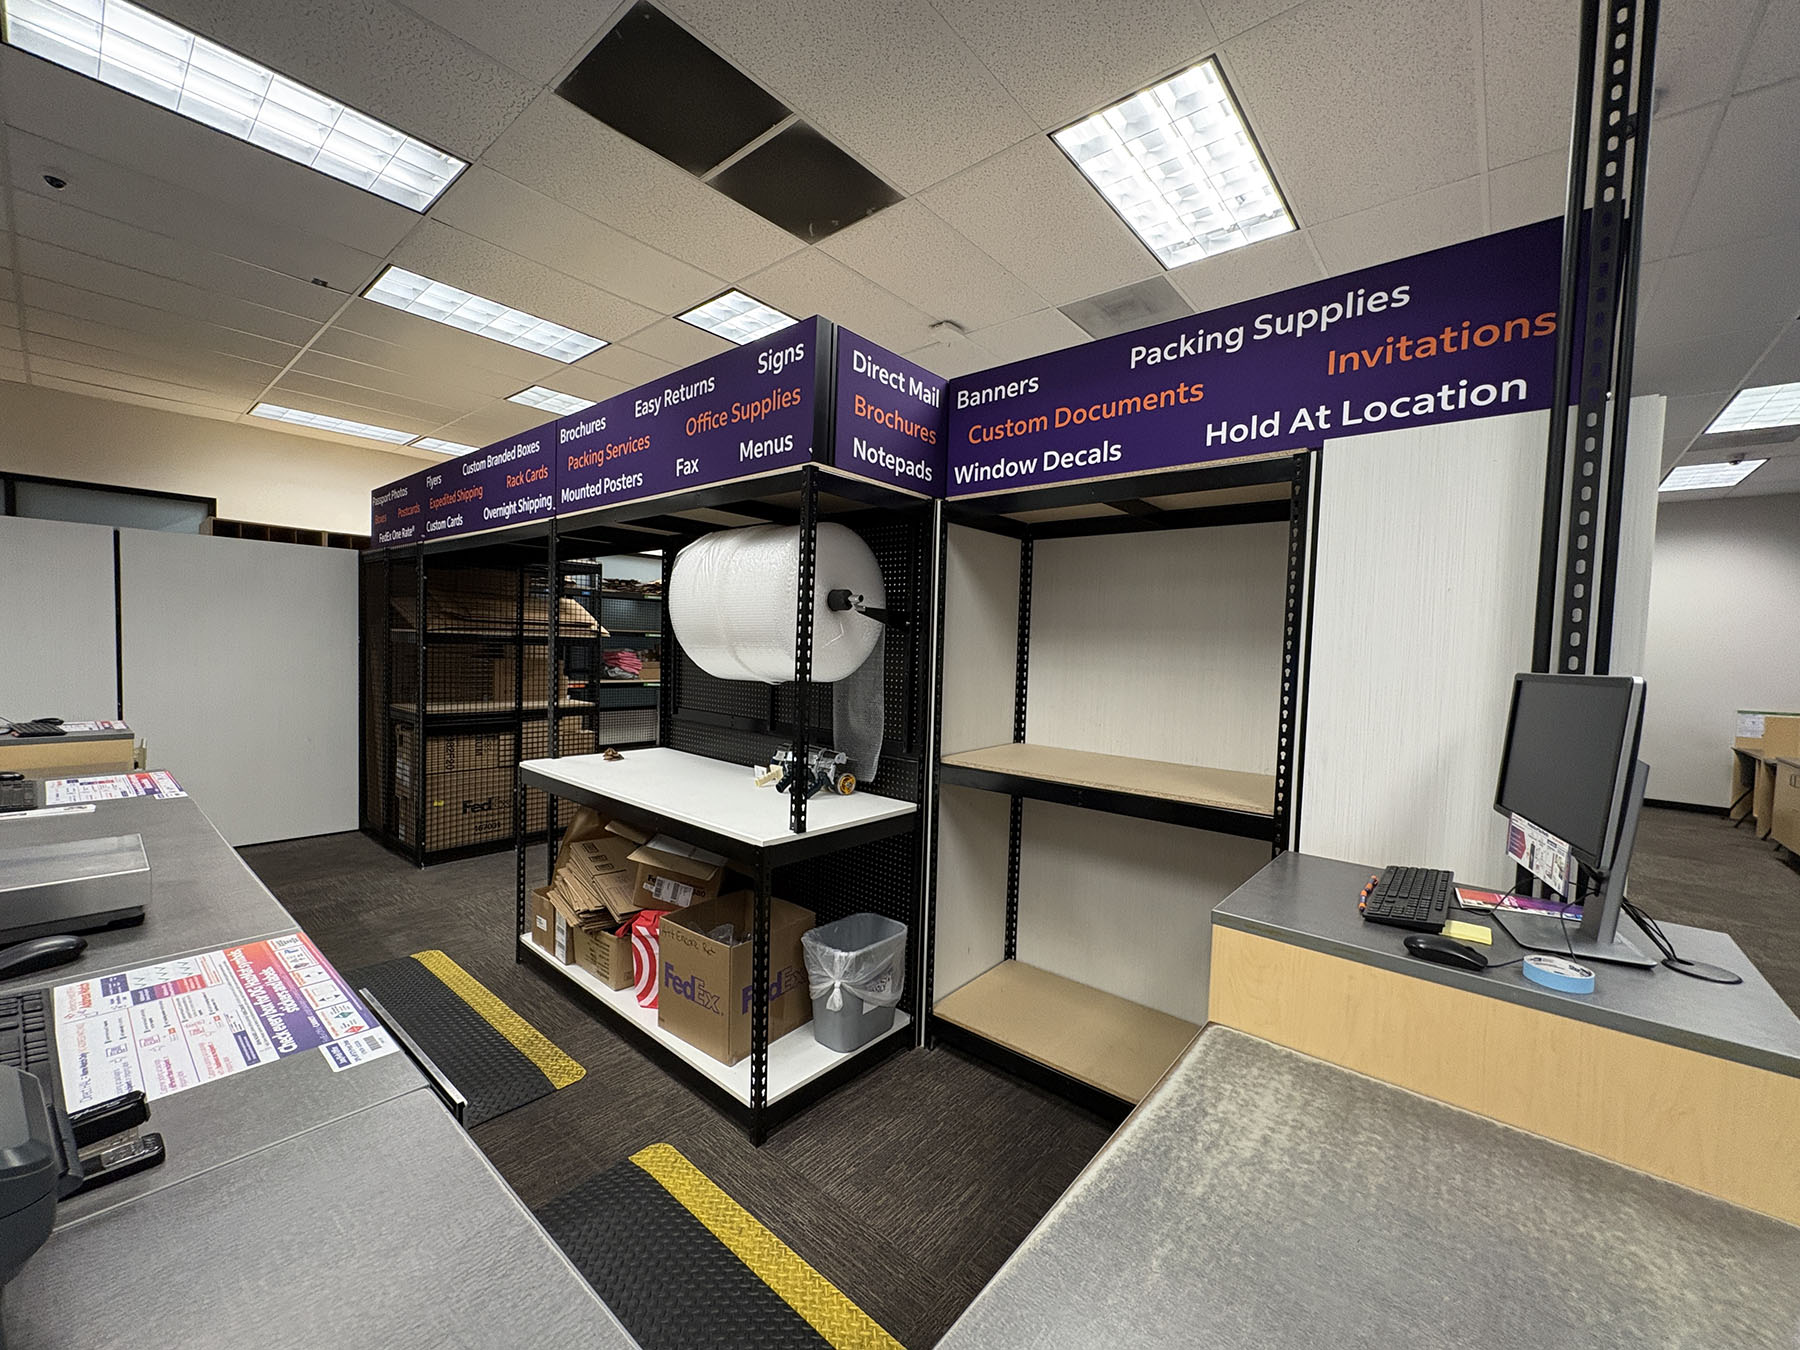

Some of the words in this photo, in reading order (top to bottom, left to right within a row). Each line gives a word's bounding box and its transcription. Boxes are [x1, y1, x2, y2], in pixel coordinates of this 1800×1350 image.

[1130, 324, 1243, 369] Packing
[1252, 284, 1411, 340] Supplies
[1327, 310, 1555, 375] Invitations
[758, 344, 804, 374] Signs
[853, 350, 905, 392] Direct
[909, 377, 939, 408] Mail
[958, 377, 1038, 409] Banners
[635, 396, 661, 417] Easy
[665, 377, 714, 405] Returns
[686, 411, 727, 436] Office
[731, 388, 800, 421] Supplies
[969, 416, 1047, 443] Custom
[1055, 383, 1203, 426] Documents
[1206, 411, 1280, 446] Hold
[1289, 405, 1330, 431] At
[1342, 379, 1528, 425] Location
[561, 417, 606, 444] Brochures
[854, 395, 937, 445] Brochures
[463, 462, 486, 475] Custom
[487, 446, 516, 467] Branded
[517, 441, 540, 458] Boxes
[568, 449, 604, 470] Packing
[606, 436, 650, 460] Services
[740, 435, 793, 461] Menus
[853, 437, 933, 482] Notepads
[955, 458, 1037, 484] Window
[1044, 441, 1121, 471] Decals
[427, 475, 441, 488] Flyers
[507, 472, 524, 487] Rack
[526, 465, 548, 482] Cards
[677, 458, 698, 476] Fax
[392, 488, 407, 499] Photos
[430, 491, 455, 508] Expedited
[457, 486, 482, 503] Shipping
[562, 479, 601, 503] Mounted
[604, 473, 643, 493] Posters
[427, 520, 446, 532] Custom
[447, 514, 463, 528] Cards
[484, 501, 517, 520] Overnight
[518, 495, 552, 514] Shipping
[380, 532, 391, 542] FedEx
[392, 530, 401, 539] One
[742, 965, 808, 1015] FdEx
